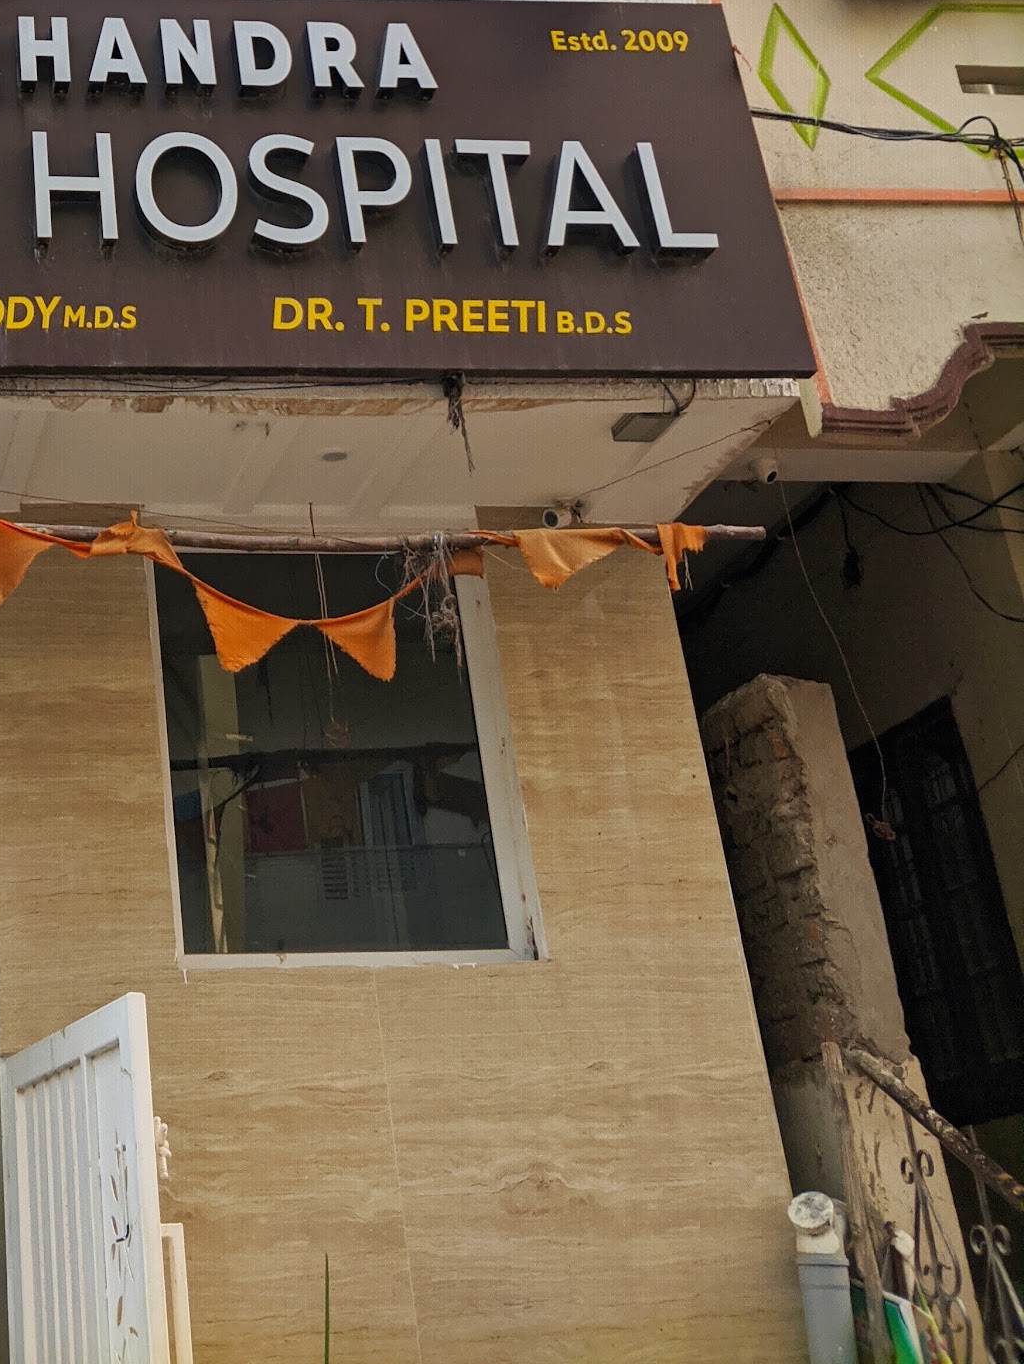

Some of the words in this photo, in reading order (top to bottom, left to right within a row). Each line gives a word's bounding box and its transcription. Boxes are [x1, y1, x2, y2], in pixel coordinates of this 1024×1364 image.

[550, 29, 617, 52] Estd.
[620, 29, 689, 53] 2009
[32, 130, 719, 250] HOSPITAL
[63, 305, 137, 330] M.D.S
[272, 297, 345, 331] DR.
[357, 297, 390, 332] T.
[405, 298, 546, 333] PREETI
[556, 311, 633, 335] B.D.S
